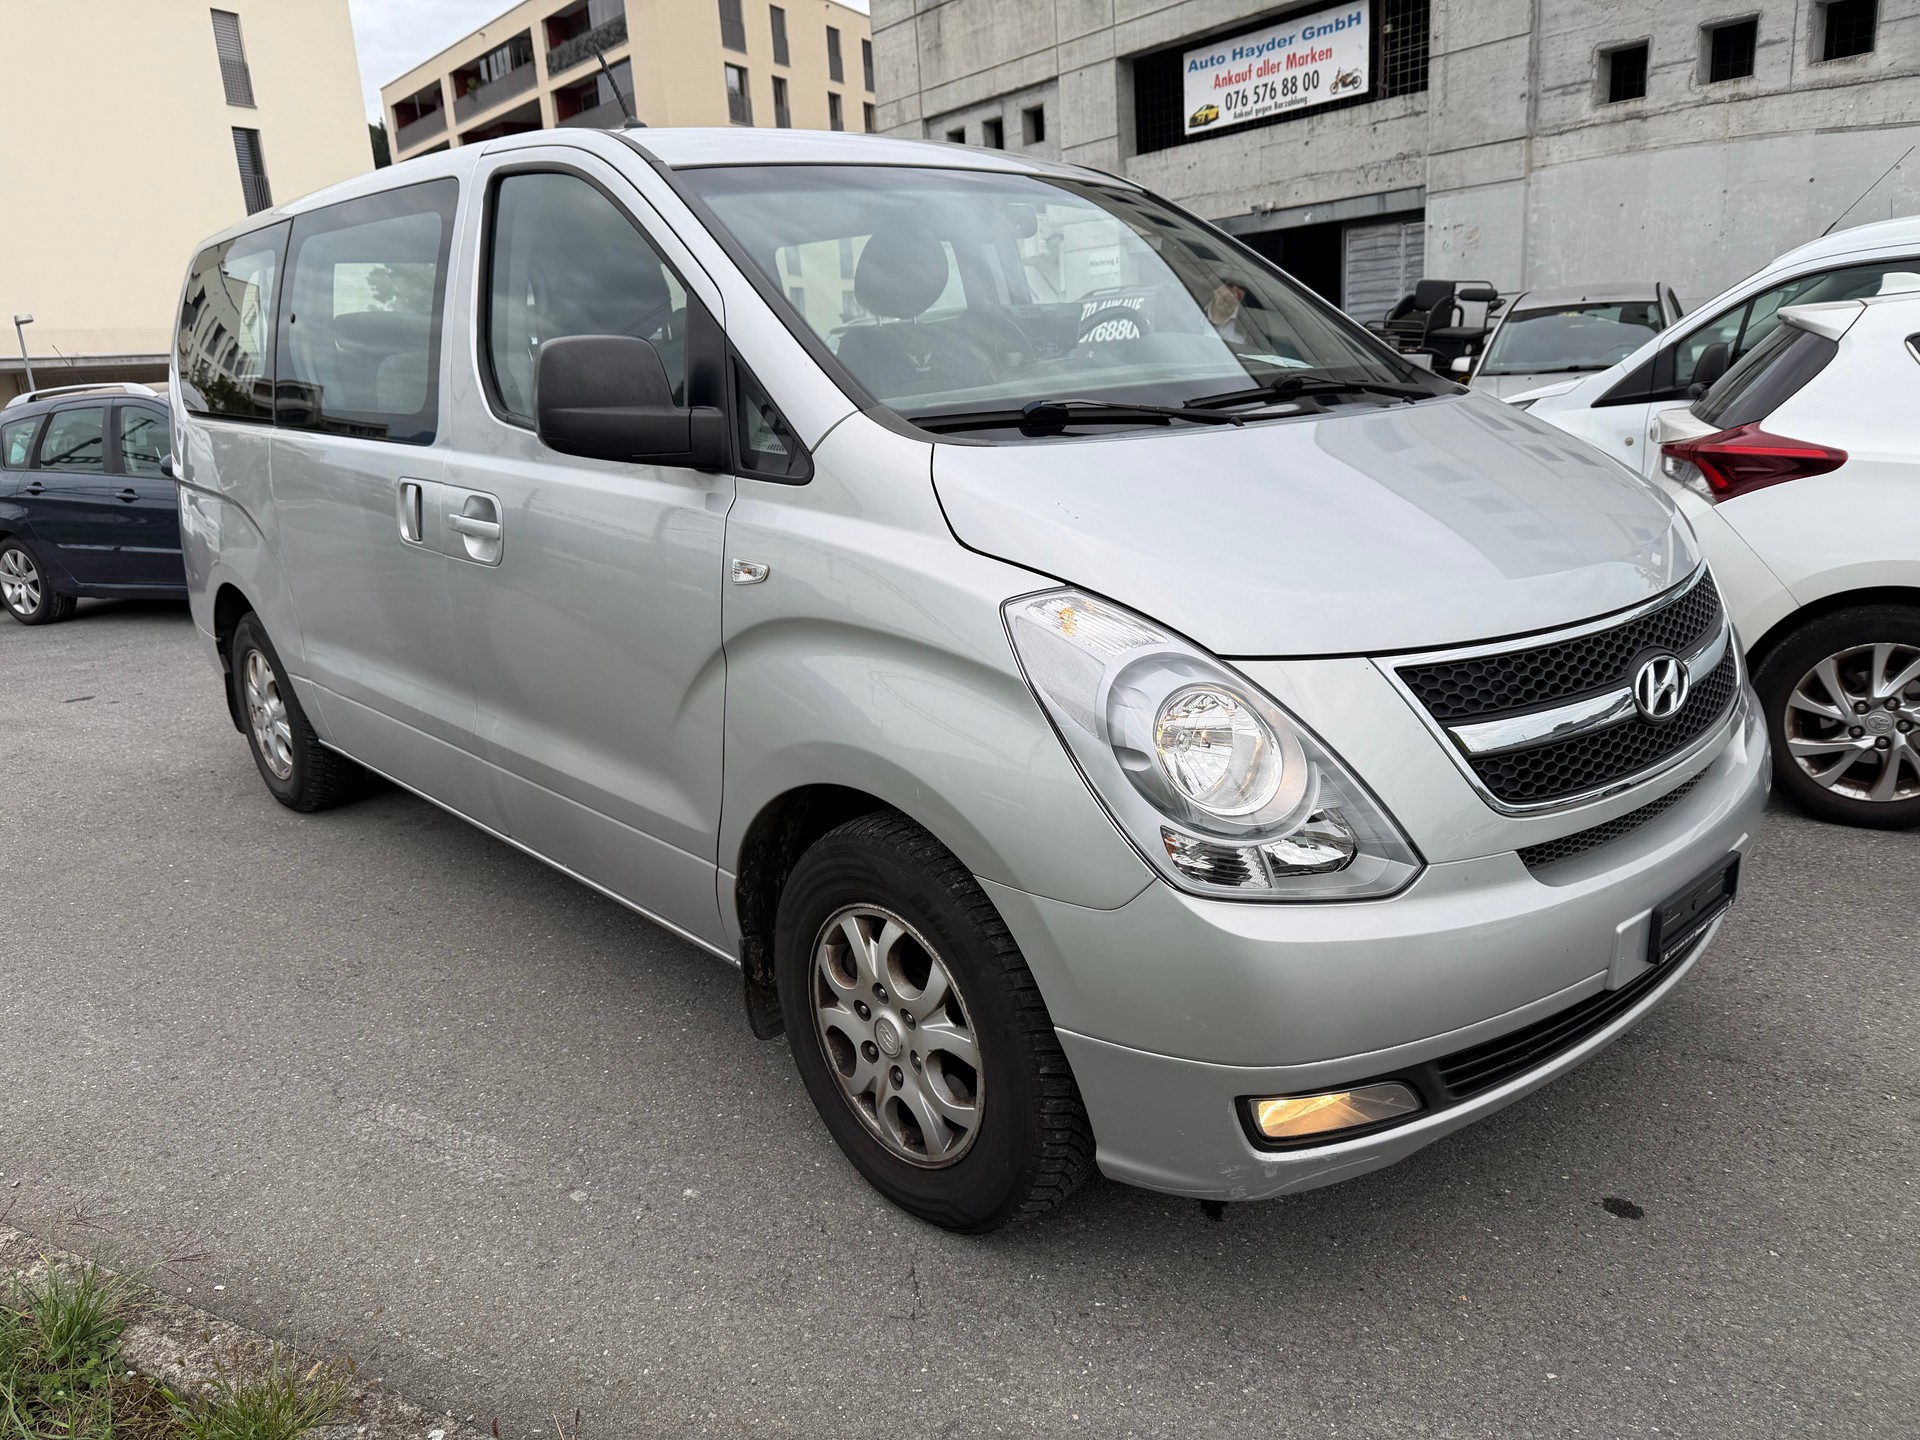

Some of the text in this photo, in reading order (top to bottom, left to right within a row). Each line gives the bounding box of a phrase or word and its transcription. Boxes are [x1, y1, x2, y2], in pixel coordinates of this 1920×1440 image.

[1188, 11, 1361, 72] Auto Hayder GmbH
[1213, 47, 1333, 90] Ankauf aller Marken
[1225, 70, 1320, 111] 076 576 88 00
[1233, 107, 1254, 120] Ankauf
[1255, 104, 1273, 117] gegen
